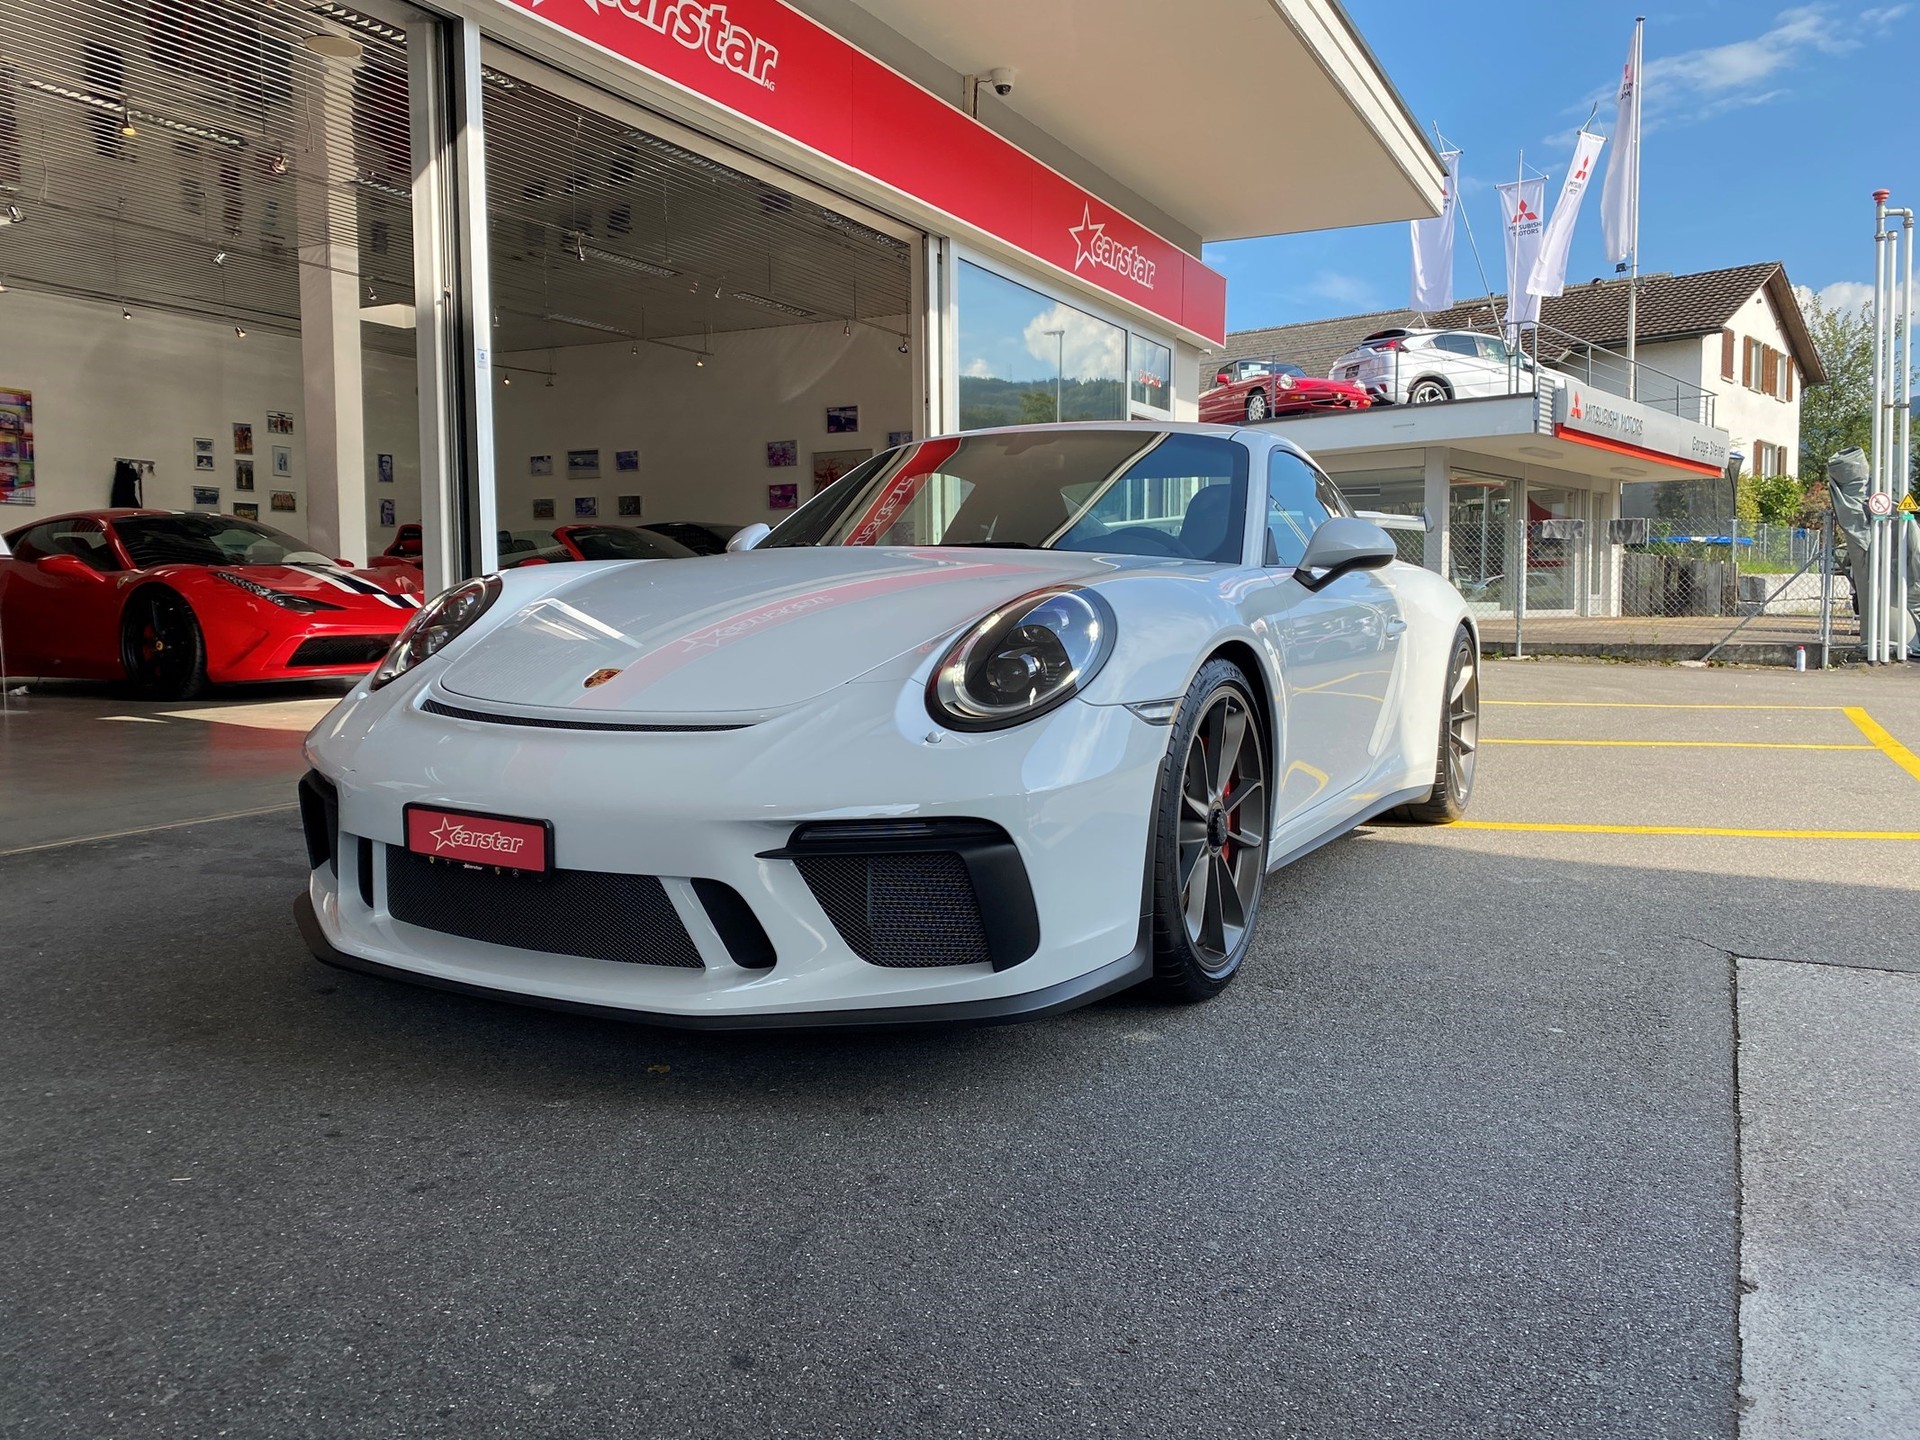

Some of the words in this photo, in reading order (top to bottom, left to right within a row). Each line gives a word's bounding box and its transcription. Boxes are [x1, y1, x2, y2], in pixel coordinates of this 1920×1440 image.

[598, 0, 779, 85] arstar
[763, 78, 776, 92] AG
[1092, 232, 1156, 288] carstar
[1585, 403, 1619, 429] MITSUBISHI
[1620, 413, 1644, 436] MOTORS
[1692, 436, 1709, 457] Garage
[451, 829, 523, 853] carstar
